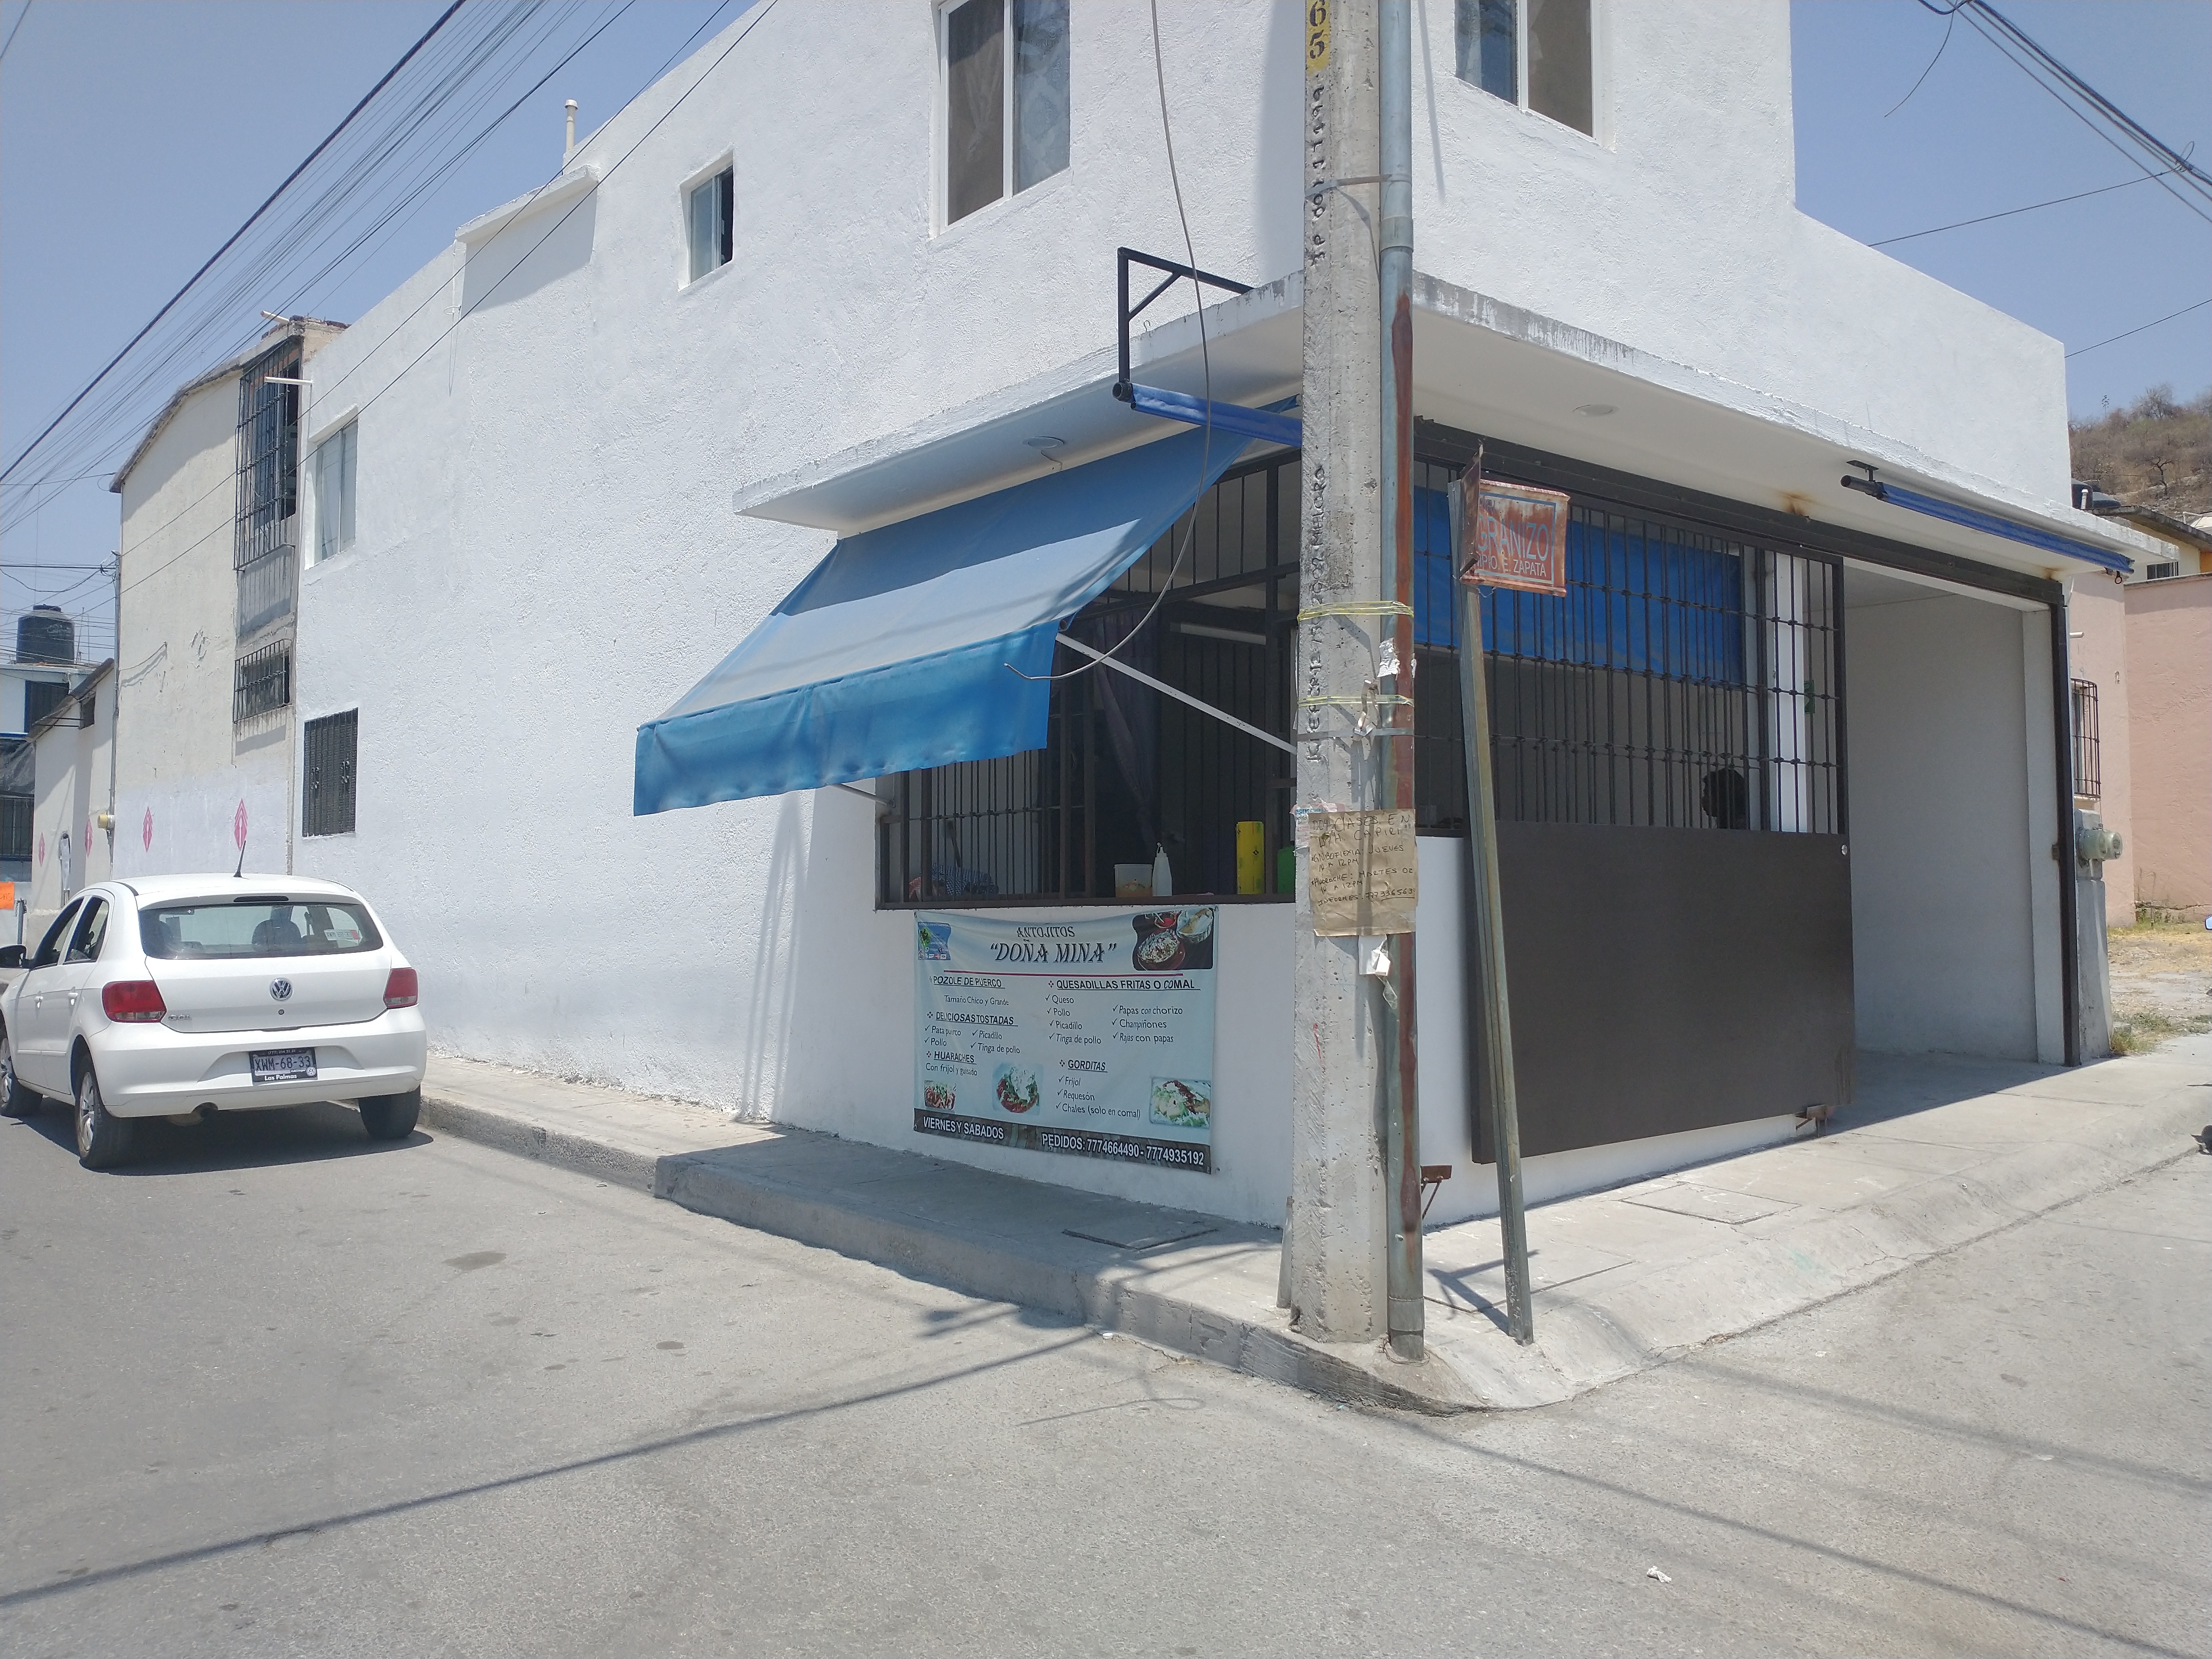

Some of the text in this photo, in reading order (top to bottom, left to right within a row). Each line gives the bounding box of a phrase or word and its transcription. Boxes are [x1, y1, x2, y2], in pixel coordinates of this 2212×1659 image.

[1479, 514, 1549, 561] GRANIZO
[1513, 559, 1546, 577] ZAPATA
[1369, 845, 1404, 854] JUEVES
[1359, 868, 1397, 878] MARTES
[1016, 926, 1076, 938] ANTOJITOS
[933, 975, 962, 985] POZOLE
[975, 978, 1002, 987] PUERCO
[1057, 979, 1195, 989] QUESADILLAS FRITAS O COMAL
[944, 995, 966, 1003] Tamaño
[990, 997, 1009, 1006] Grande
[1052, 995, 1074, 1004] Queso
[1054, 1008, 1070, 1017] Pollo
[1119, 1005, 1139, 1016] Papas
[1152, 1006, 1183, 1015] chorizo
[936, 1011, 1014, 1025] DELICIOSAS TOSTADAS
[932, 1025, 944, 1034] Pata
[1056, 1021, 1082, 1030] Picadillo
[1119, 1019, 1167, 1031] Champiñones
[979, 1030, 1002, 1040] Picadillo
[1056, 1033, 1102, 1046] Tinga de pollo
[1119, 1032, 1174, 1045] Rajas con papas
[931, 1038, 947, 1046] Pollo
[978, 1042, 1021, 1055] Tinga de pollo
[934, 1051, 974, 1063] HUARACHES
[254, 1056, 311, 1071] XWM-68-33
[926, 1062, 938, 1071] Con
[940, 1063, 954, 1074] frijol
[960, 1068, 978, 1076] guisado
[1068, 1059, 1106, 1071] GORDITAS
[1065, 1076, 1081, 1088] Frijol
[1063, 1090, 1095, 1102] Requesón
[1062, 1103, 1085, 1113] Chales
[1088, 1105, 1106, 1116] (solo
[1118, 1109, 1141, 1121] comal)
[923, 1116, 956, 1133] VIERNES
[964, 1122, 1004, 1140] SABADOS
[1042, 1133, 1085, 1151] PEDIDOS:
[1146, 1146, 1204, 1165] 7774935192
